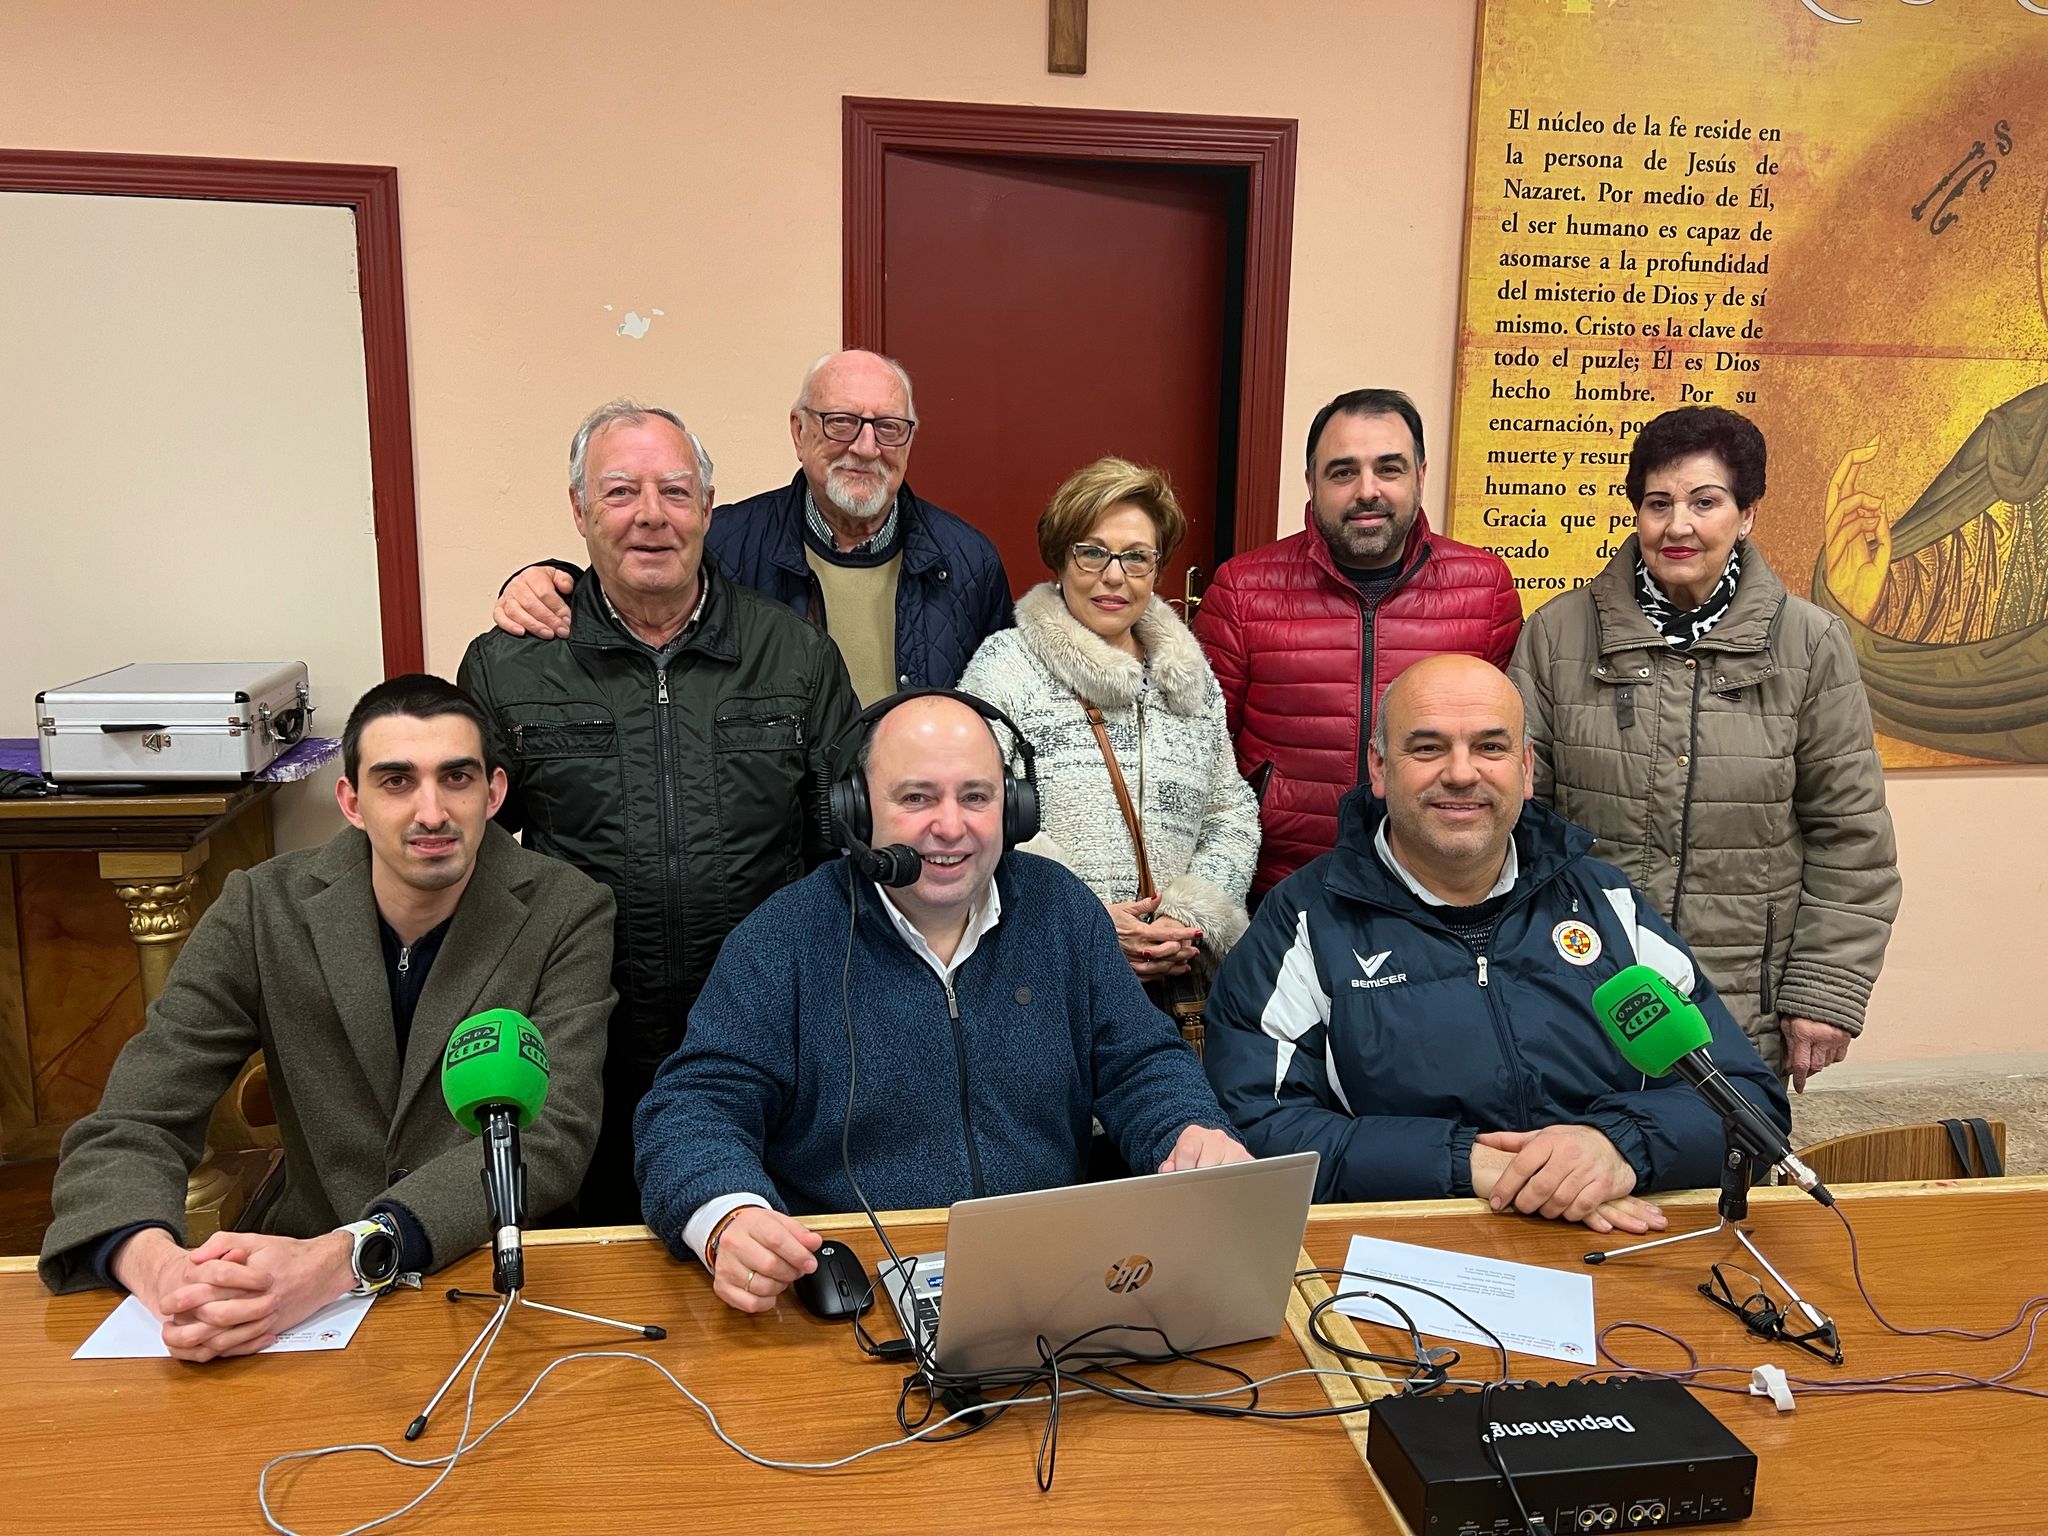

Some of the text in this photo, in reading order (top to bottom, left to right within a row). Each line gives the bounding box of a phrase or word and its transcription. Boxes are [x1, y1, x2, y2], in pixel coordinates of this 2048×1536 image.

[1508, 108, 1781, 142] El núcleo de la fe reside en
[1505, 142, 1779, 177] la persona de Jesús de
[1503, 178, 1775, 212] Nazaret. Por medio de Él,
[1501, 211, 1518, 233] el
[1527, 220, 1557, 234] ser
[1565, 213, 1649, 238] humano
[1658, 225, 1678, 239] es
[1686, 226, 1741, 247] capaz
[1749, 221, 1773, 242] de
[1499, 249, 1769, 278] asomarse a la profundidad
[1497, 279, 1768, 312] del misterio de Dios y de sí
[1495, 313, 1764, 339] mismo. Cristo es la clave de
[1494, 345, 1761, 375] todo el puzle; Él es Dios
[1490, 377, 1757, 404] hecho hombre. Por su
[1489, 413, 1644, 440] encarnación, po
[1487, 449, 1629, 471] muerte y resur
[1484, 475, 1567, 496] humano
[1578, 483, 1596, 496] es
[1483, 507, 1547, 527] Gracia
[1560, 515, 1596, 534] que
[1514, 576, 1565, 589] meros
[1351, 973, 1407, 989] BEMISER
[1618, 995, 1650, 1019] ONDA
[1629, 1005, 1659, 1030] CERO
[453, 1028, 492, 1047] ONDA
[454, 1040, 491, 1059] CERO
[1104, 1255, 1153, 1294] hp
[1489, 1414, 1636, 1441] Depusheng
